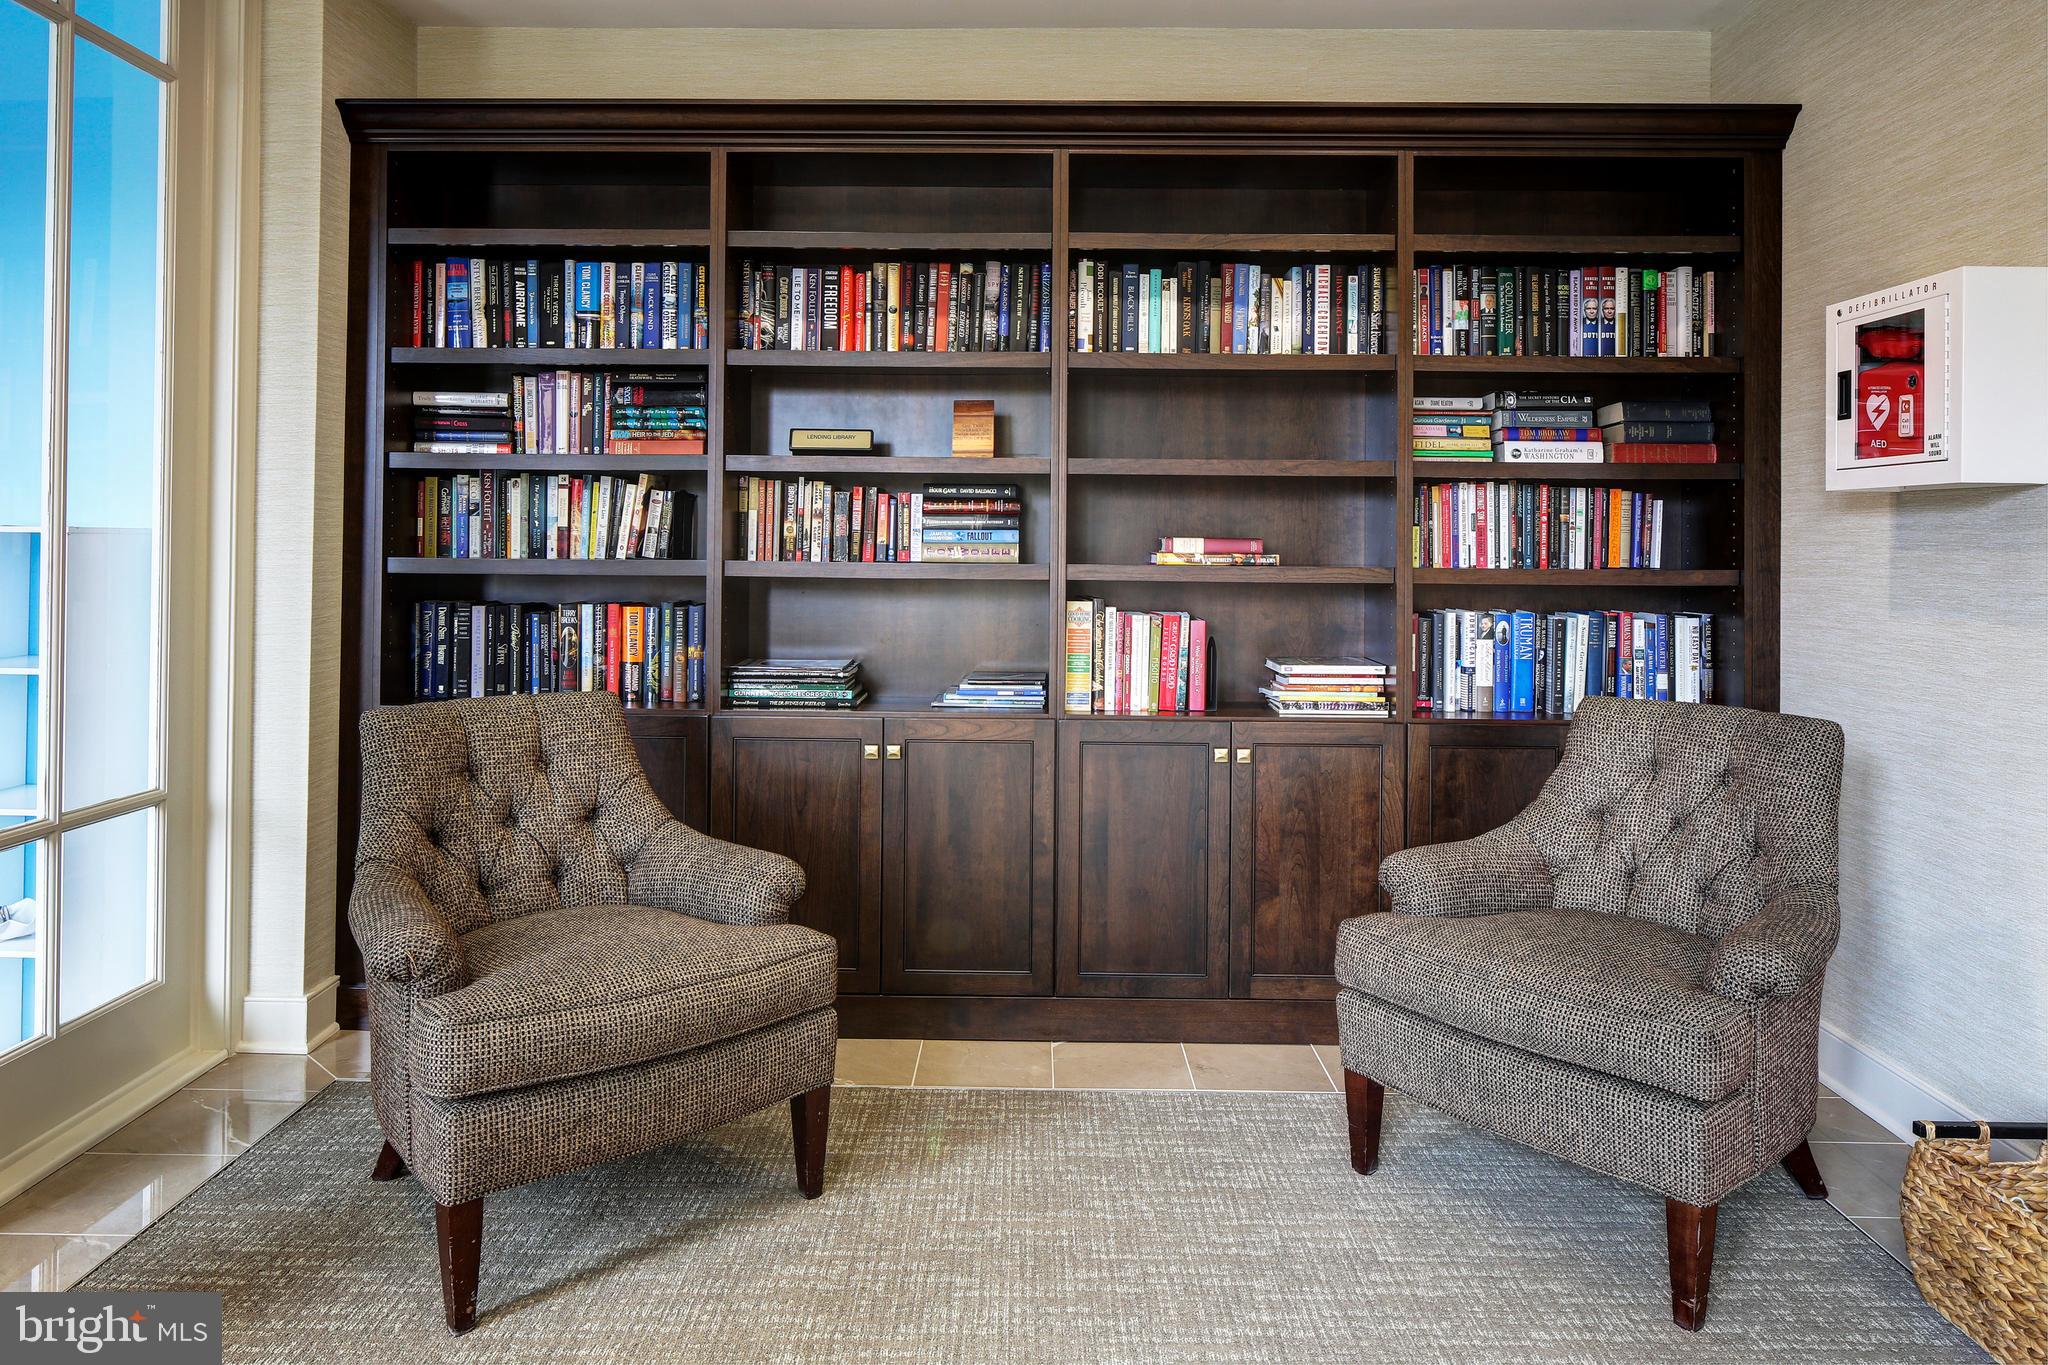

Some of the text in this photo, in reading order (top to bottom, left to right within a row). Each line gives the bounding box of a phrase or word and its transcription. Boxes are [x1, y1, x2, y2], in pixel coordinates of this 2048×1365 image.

[582, 265, 591, 308] TOM CLANCY
[794, 290, 800, 300] TO
[1318, 268, 1328, 304] MICHAEL
[1848, 282, 1938, 314] DEFIBRILLATOR
[516, 281, 525, 327] AIRFRAME
[794, 303, 800, 314] ME
[808, 291, 816, 323] FOLLETT
[824, 285, 838, 329] FREEDOM
[1561, 396, 1577, 404] CIA
[1870, 439, 1887, 448] AED
[967, 532, 992, 540] FALLOUT
[629, 611, 638, 656] TOM CLANCY
[1520, 617, 1533, 660] TRUMAN
[1692, 626, 1698, 634] NO
